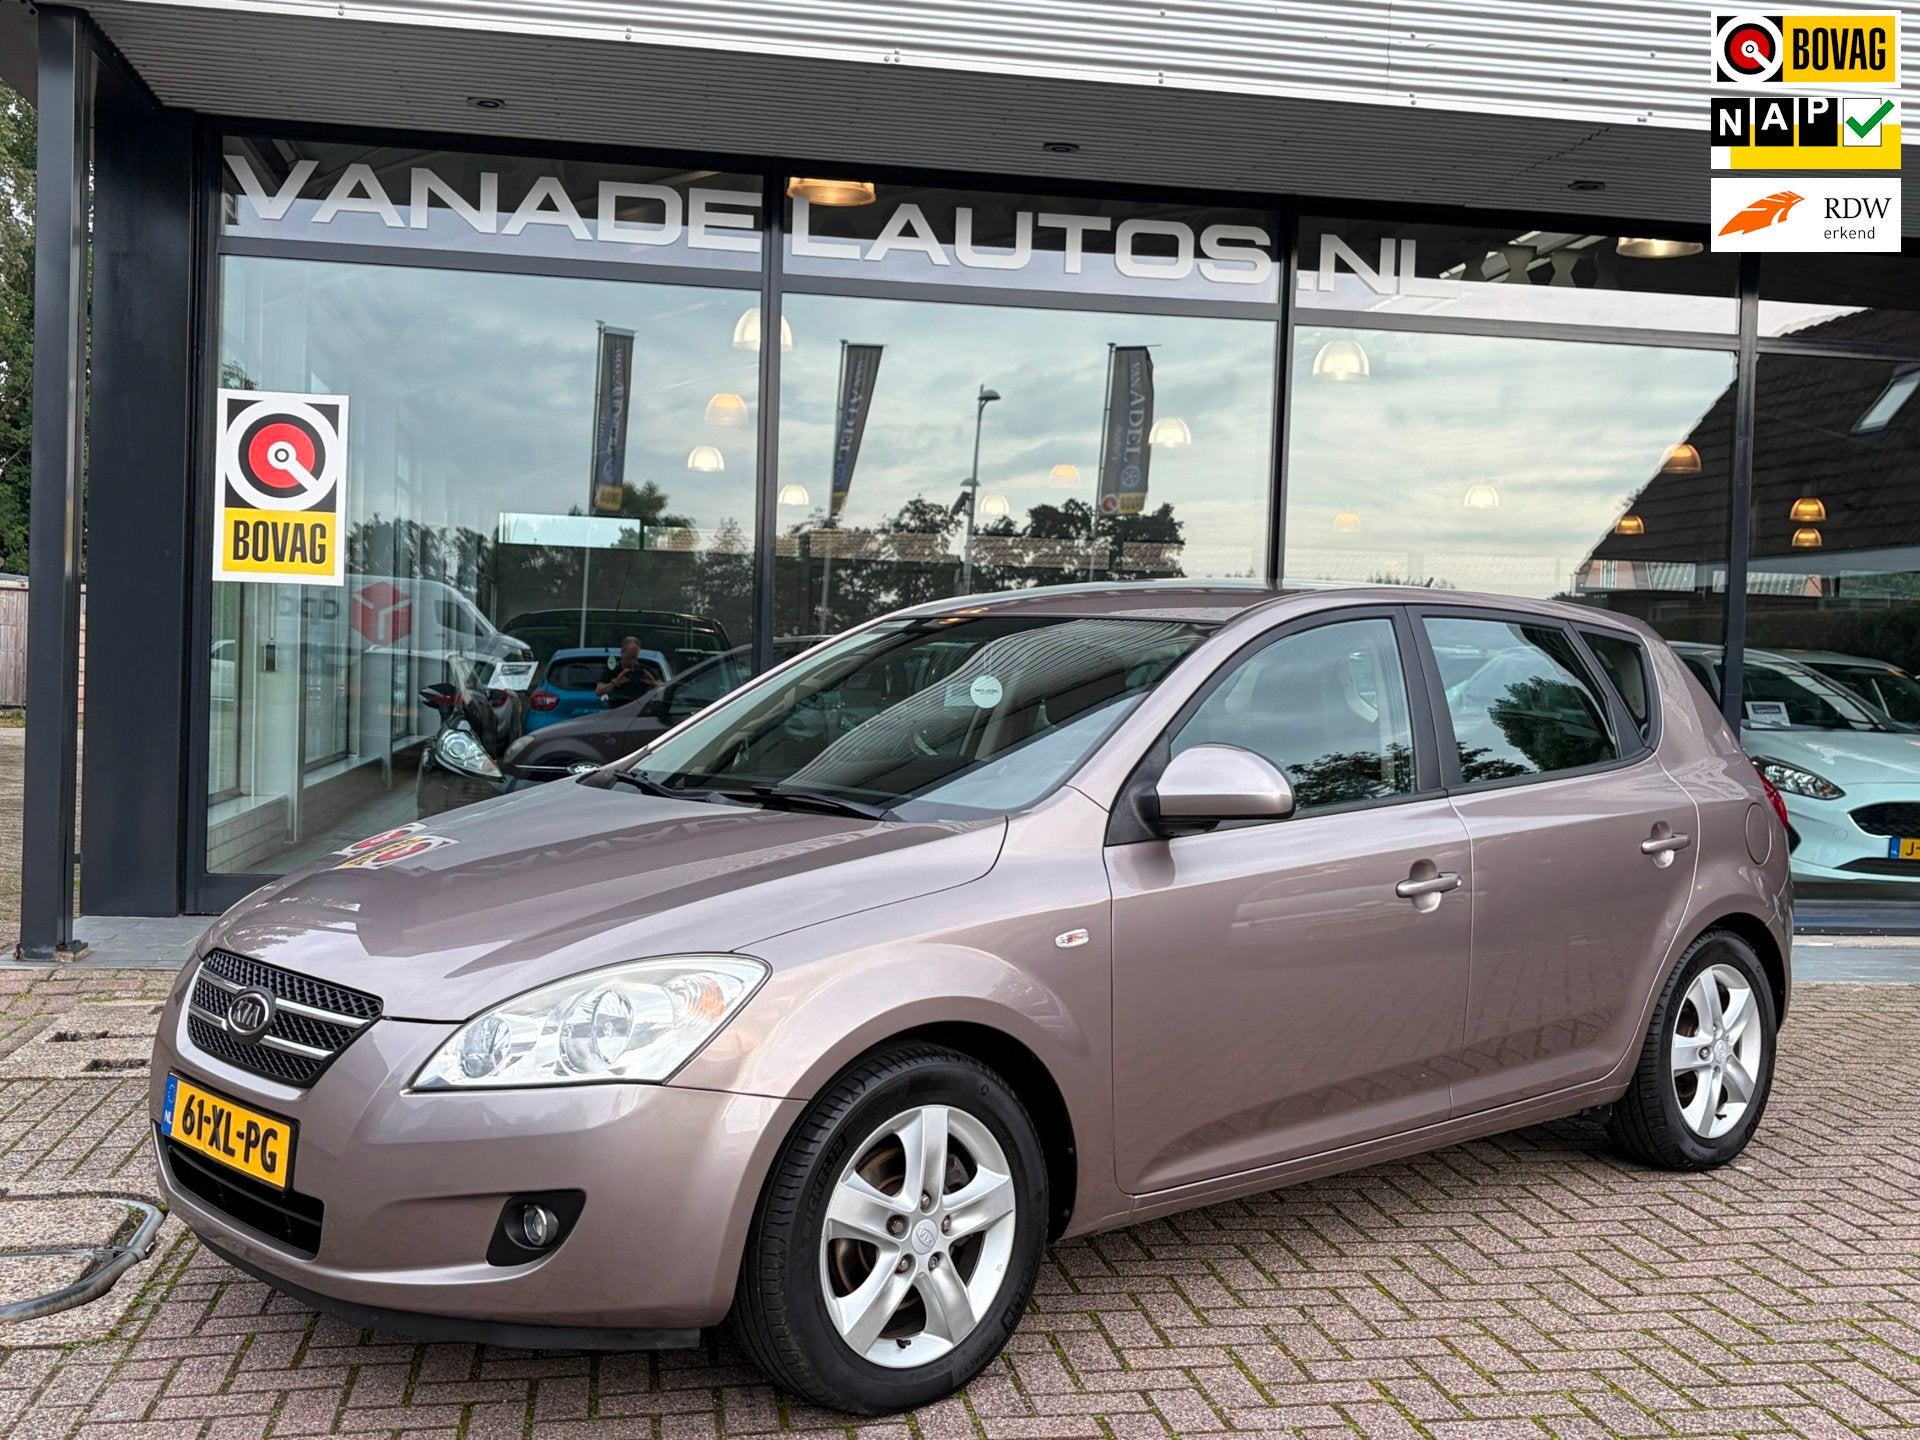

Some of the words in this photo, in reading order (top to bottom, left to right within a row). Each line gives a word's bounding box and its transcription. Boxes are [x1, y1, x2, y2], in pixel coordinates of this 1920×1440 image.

[1124, 390, 1146, 462] ADEL
[232, 520, 326, 565] BOVAG
[163, 1109, 172, 1125] NL
[182, 1094, 278, 1173] 61-XL-PG
